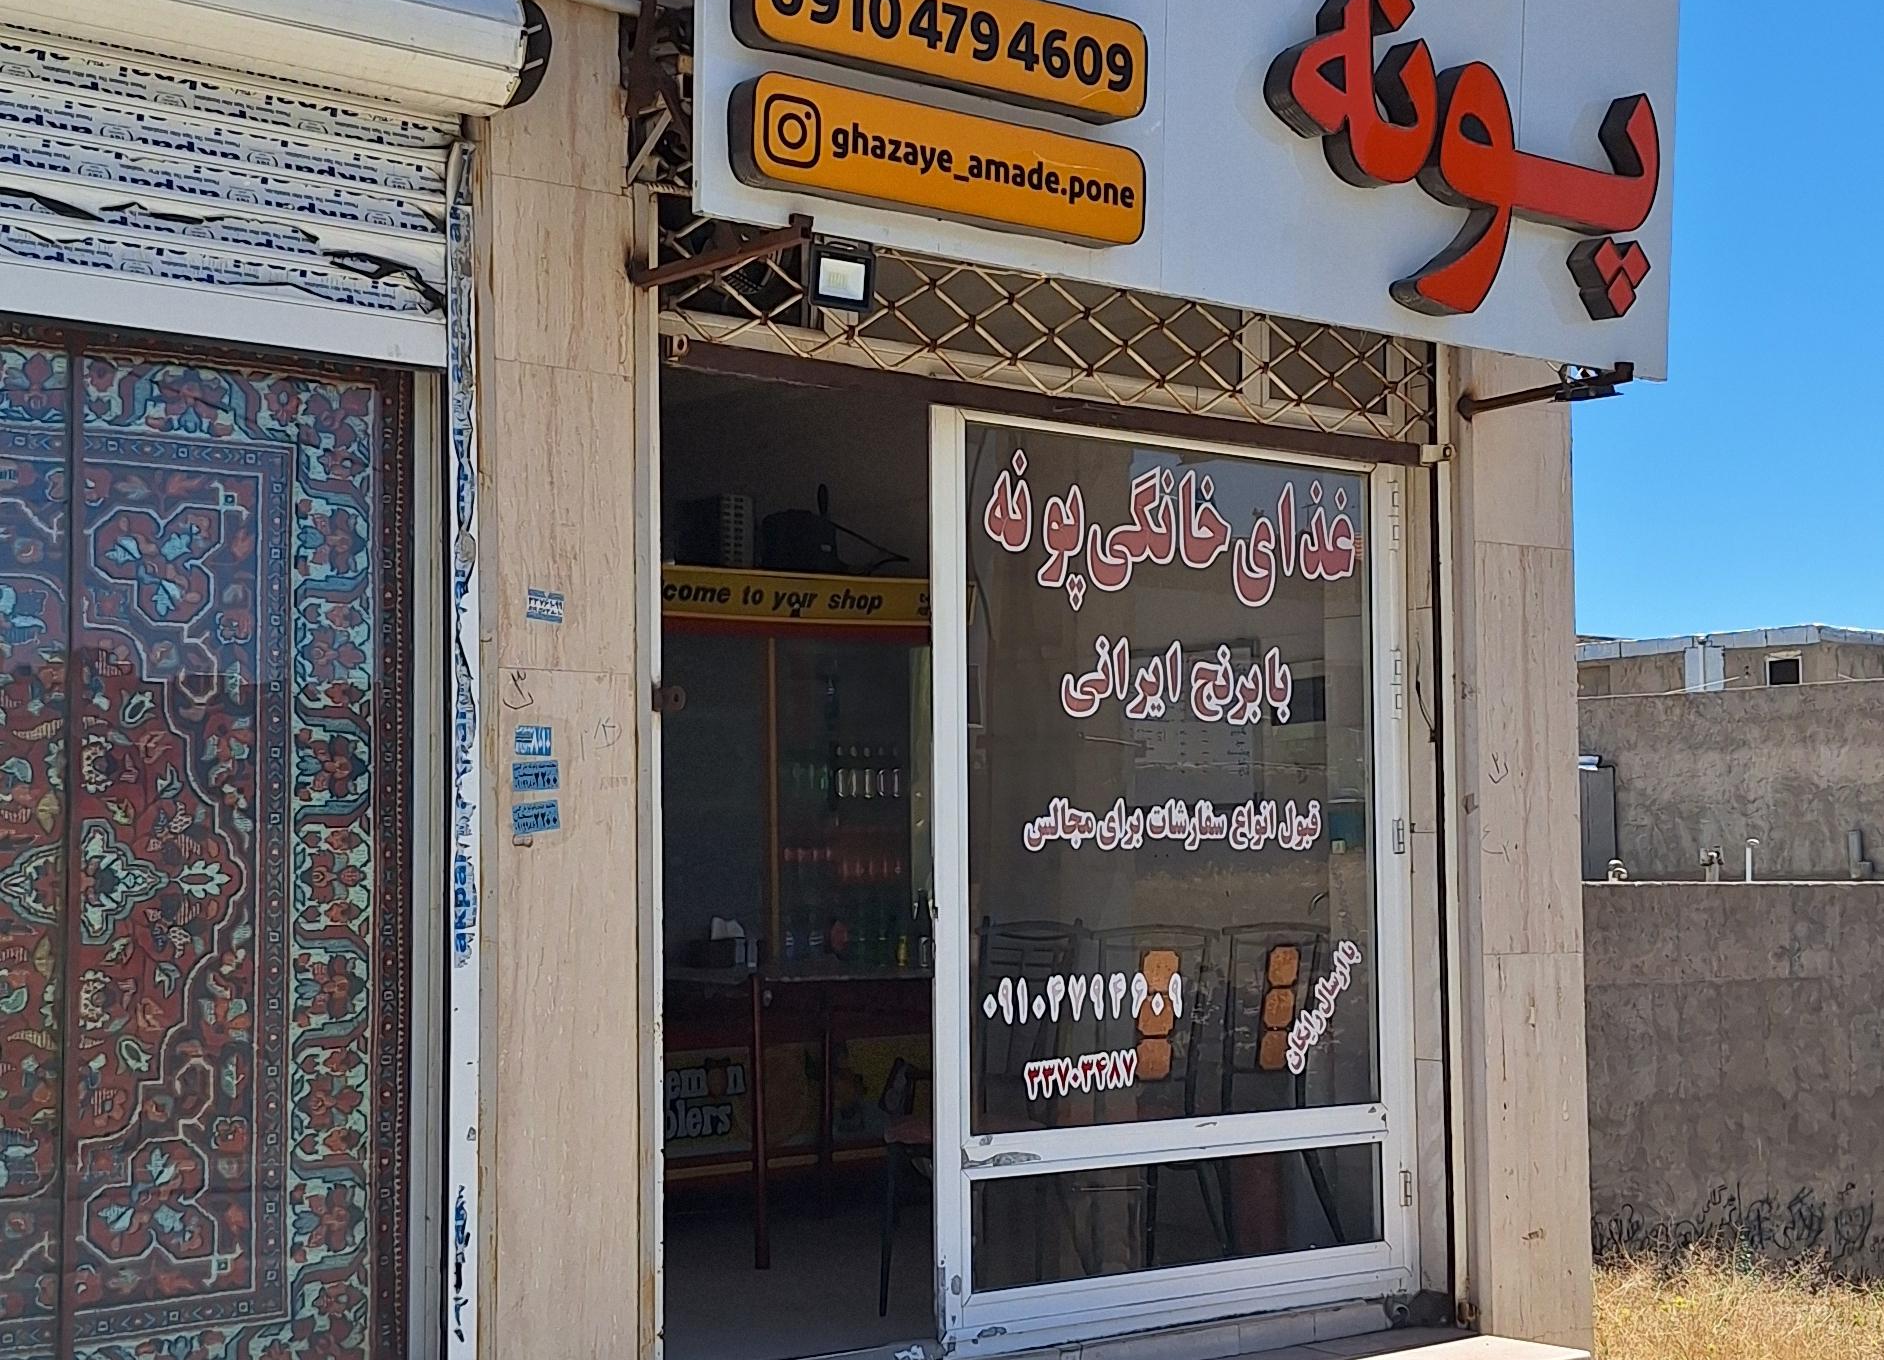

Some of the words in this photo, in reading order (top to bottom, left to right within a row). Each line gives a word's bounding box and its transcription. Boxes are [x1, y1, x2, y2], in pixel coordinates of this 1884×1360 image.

[831, 122, 1135, 208] ghazaye_amade.pone
[1086, 466, 1232, 592] خانگی
[1233, 480, 1357, 607] غذای
[742, 585, 764, 607] to
[827, 587, 884, 616] shop
[1061, 635, 1183, 719] ایرانی
[1189, 643, 1263, 724] برنج
[1263, 646, 1293, 723] با
[1023, 797, 1097, 852] مجالس
[1096, 797, 1144, 850] برای
[1146, 798, 1228, 851] سفارشات
[1229, 800, 1277, 850] انواع
[1278, 800, 1322, 849] قبول
